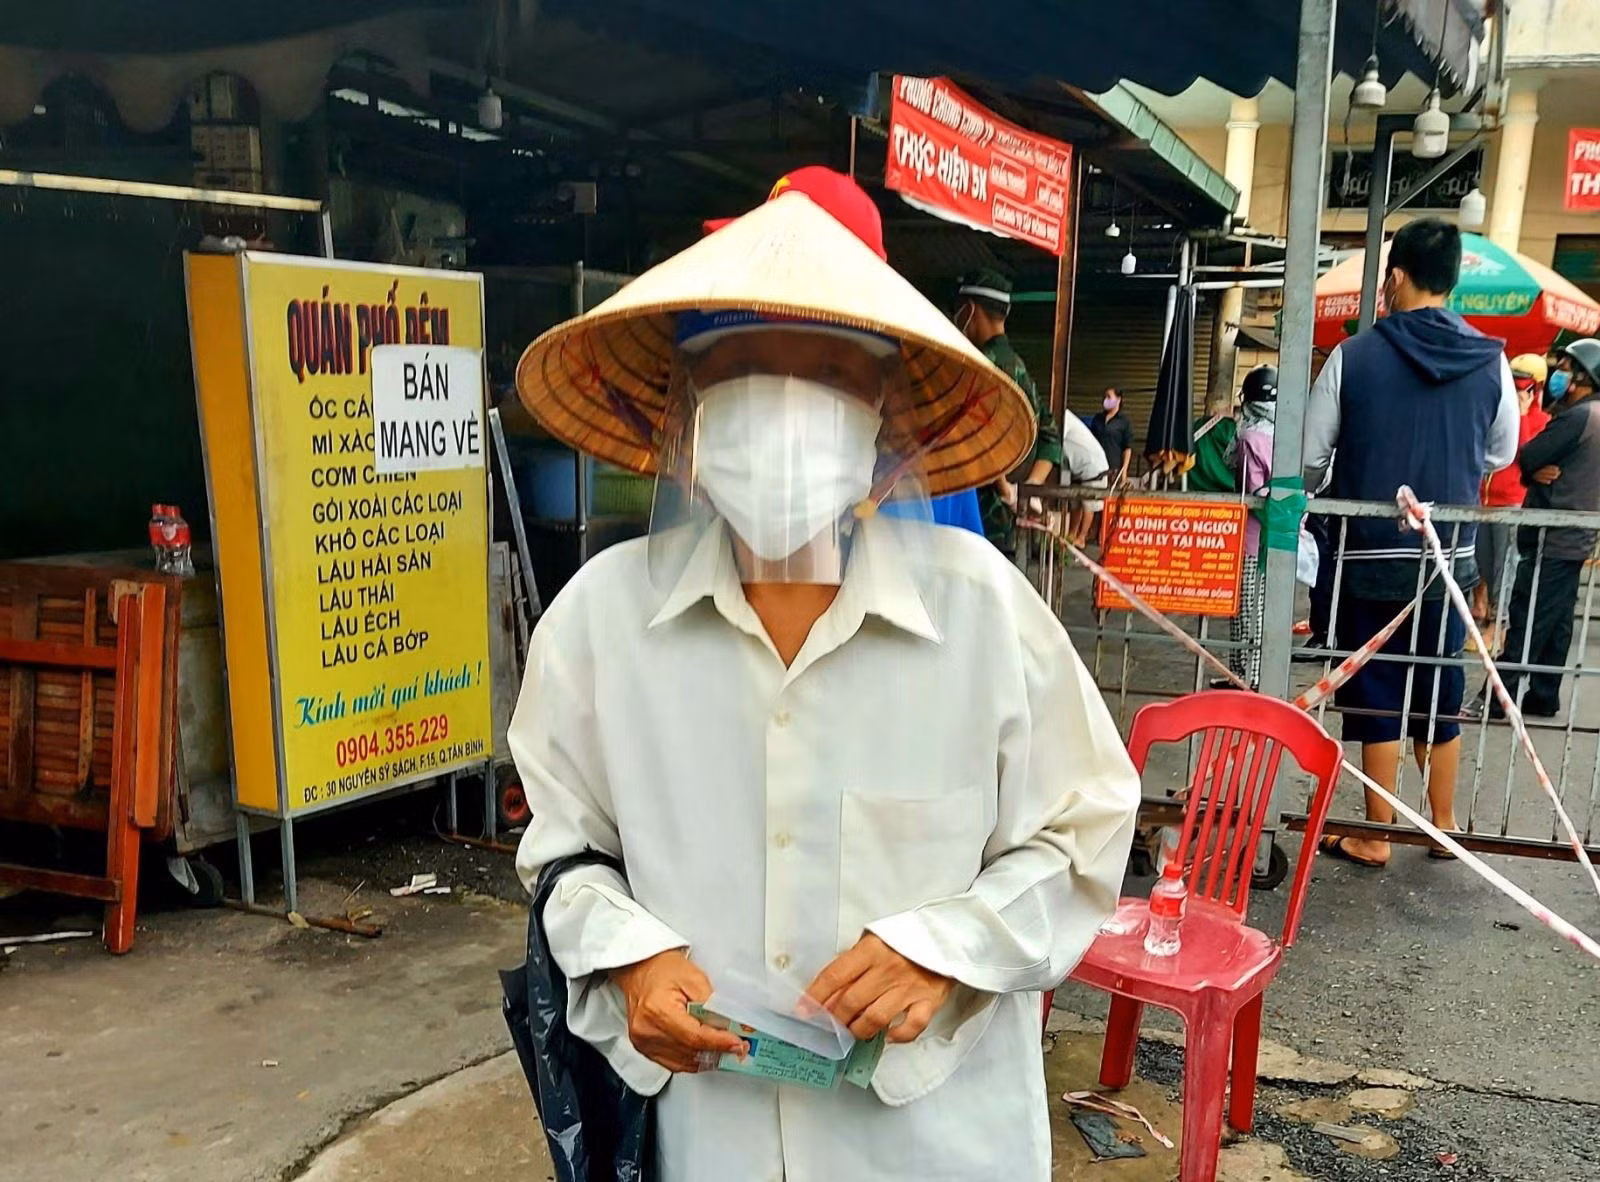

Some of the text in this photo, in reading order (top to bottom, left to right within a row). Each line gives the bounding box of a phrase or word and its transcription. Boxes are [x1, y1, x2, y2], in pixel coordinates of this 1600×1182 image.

[894, 123, 935, 184] THỰC
[287, 284, 353, 384] QUÁN
[404, 353, 449, 400] BÁN
[344, 394, 374, 419] CÁ
[380, 420, 446, 458] MANG
[311, 465, 357, 488] CƠM
[391, 490, 423, 516] CÁC
[428, 490, 462, 517] LOẠI
[362, 523, 400, 547] CÁC
[405, 521, 445, 545] LOẠI
[1134, 516, 1167, 531] ĐÌNH
[1170, 518, 1189, 532] CÓ
[1192, 520, 1238, 535] NGƯỜI
[1118, 530, 1226, 550] CÁCH LY TẠI NHÀ
[363, 635, 389, 660] CÁ
[423, 663, 471, 698] khách
[336, 714, 449, 768] 0904.355.229
[326, 777, 337, 797] 30
